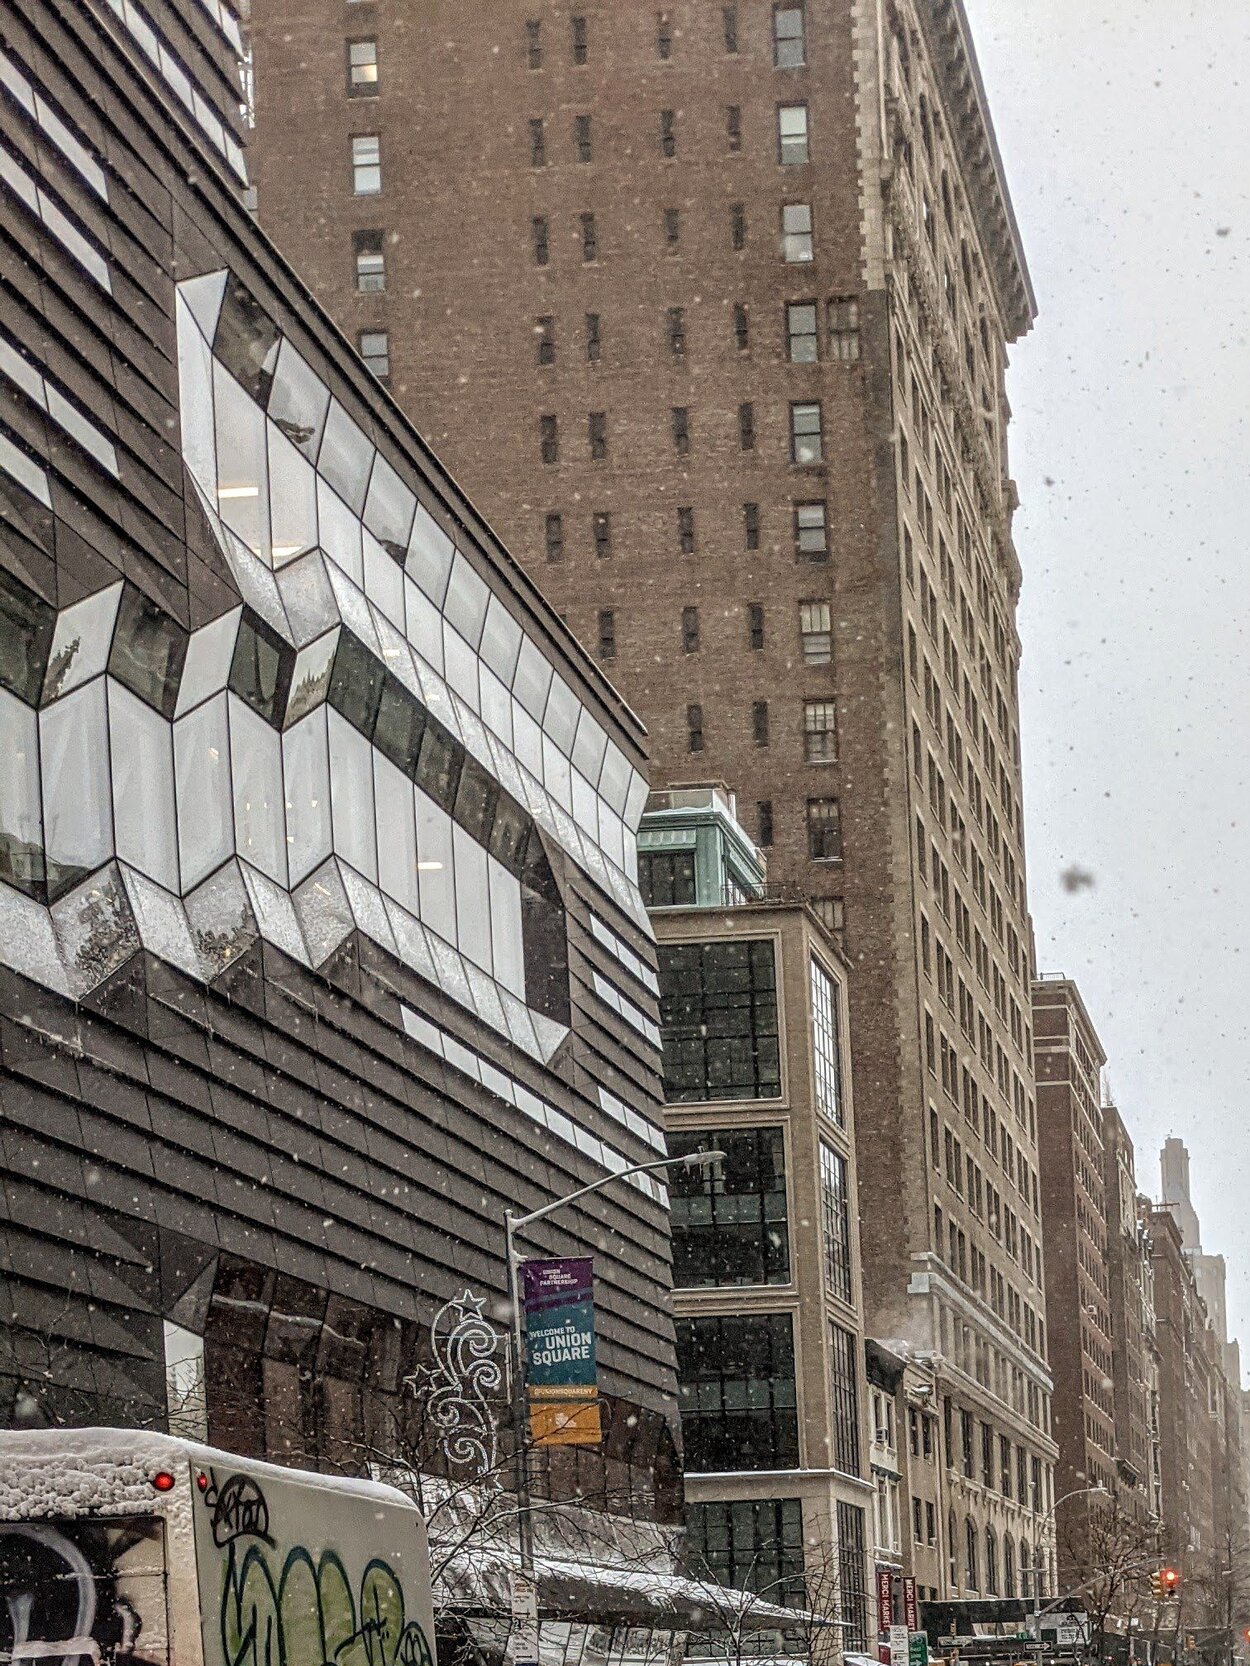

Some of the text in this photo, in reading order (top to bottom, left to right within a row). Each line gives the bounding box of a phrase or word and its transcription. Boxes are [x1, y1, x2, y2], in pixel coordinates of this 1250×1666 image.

[529, 1326, 576, 1339] WELCOME TO
[545, 1331, 592, 1349] UNION
[532, 1346, 590, 1367] SQUARE
[881, 1573, 890, 1628] MERCI MARKET
[905, 1579, 916, 1631] MERCI MARKET
